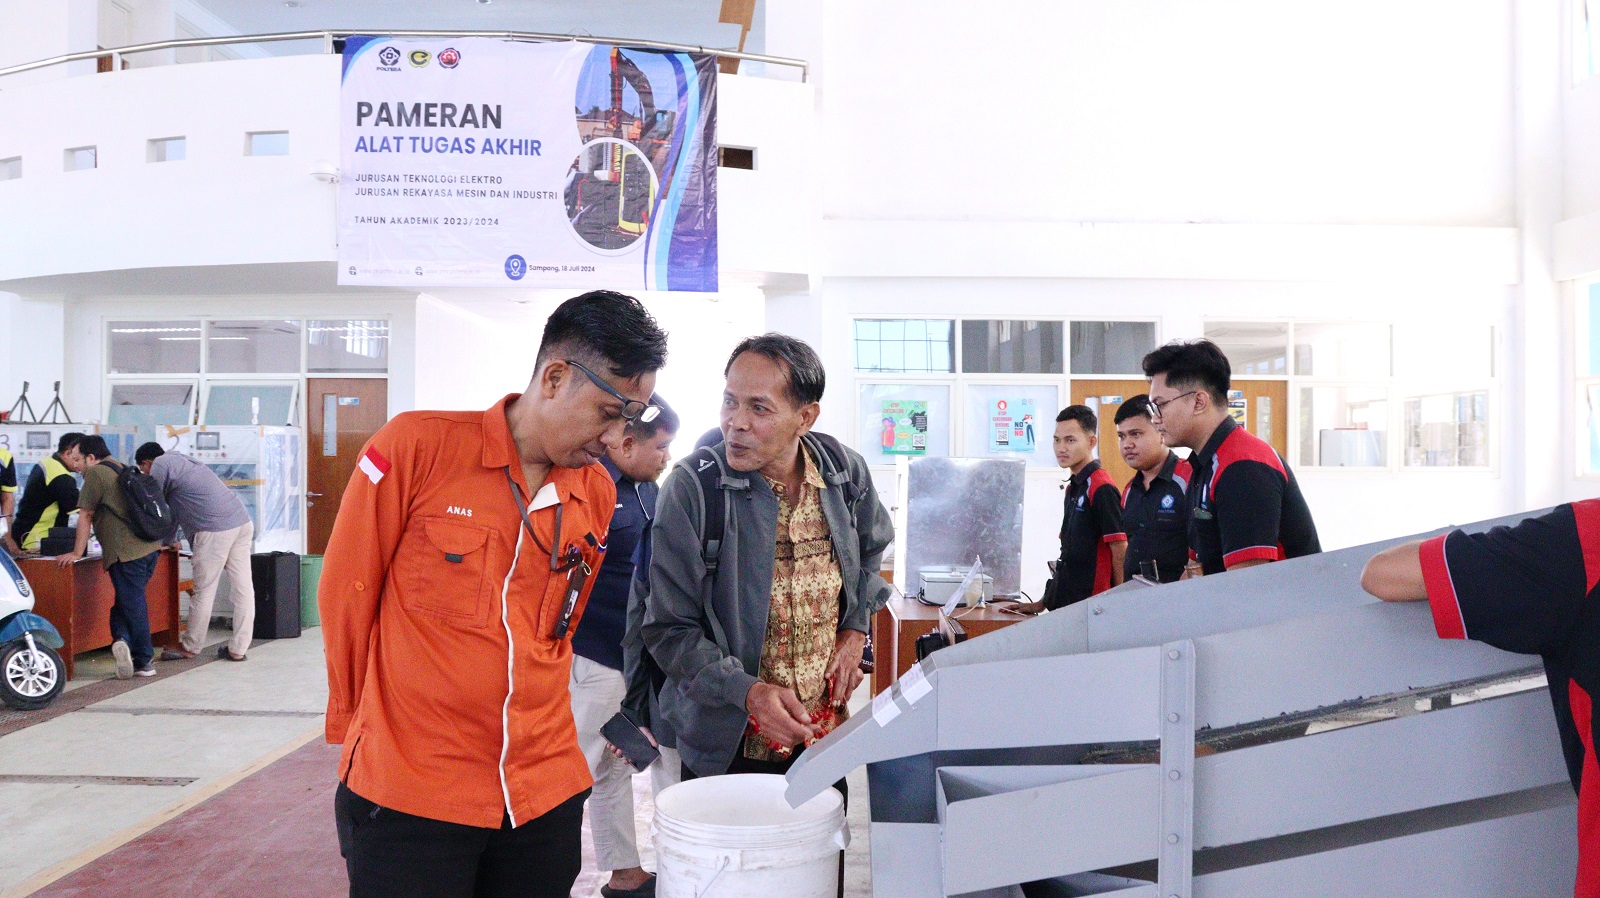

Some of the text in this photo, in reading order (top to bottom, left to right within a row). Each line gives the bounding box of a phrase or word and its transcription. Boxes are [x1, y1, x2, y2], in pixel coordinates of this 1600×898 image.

[356, 101, 502, 129] PAMERAN
[355, 135, 542, 156] ALAT TUGAS AKHIR
[355, 173, 503, 184] JURUSAN TEKNOLOGI ELEKTRO
[355, 187, 558, 200] JURUSAN REKAYASA MESIN DAN INDUSTRI
[354, 215, 499, 226] TAHUN AKADEMIK 2023/2024
[528, 264, 560, 273] Sampang,
[446, 505, 473, 517] ANAS
